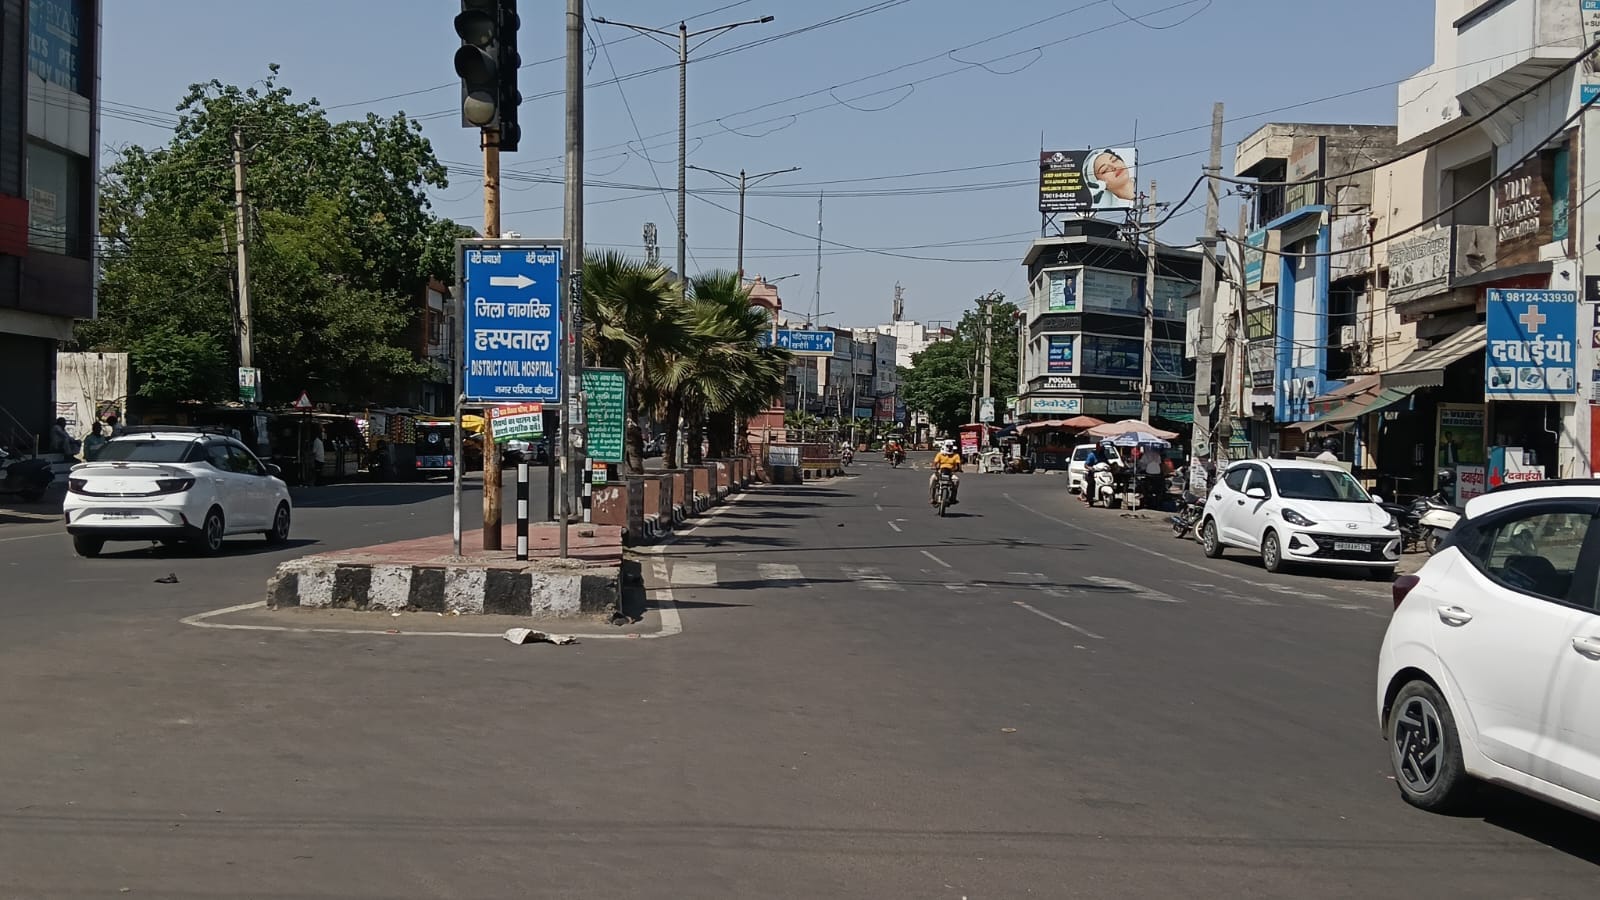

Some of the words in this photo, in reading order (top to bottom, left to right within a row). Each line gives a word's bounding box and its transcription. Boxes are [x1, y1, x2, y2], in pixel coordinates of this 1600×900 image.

[470, 251, 481, 264] बेटी
[482, 252, 501, 264] बचाओ
[525, 251, 536, 264] बेटी
[1506, 292, 1575, 303] 98124-33930
[474, 297, 506, 318] जिला
[507, 298, 551, 319] नागरिक
[474, 328, 552, 351] हस्पताल
[471, 360, 502, 376] DISTRICT
[502, 360, 520, 377] CIVIL
[521, 361, 554, 377] HOSPITAL
[1048, 376, 1072, 384] POOJA
[495, 386, 511, 394] नगर
